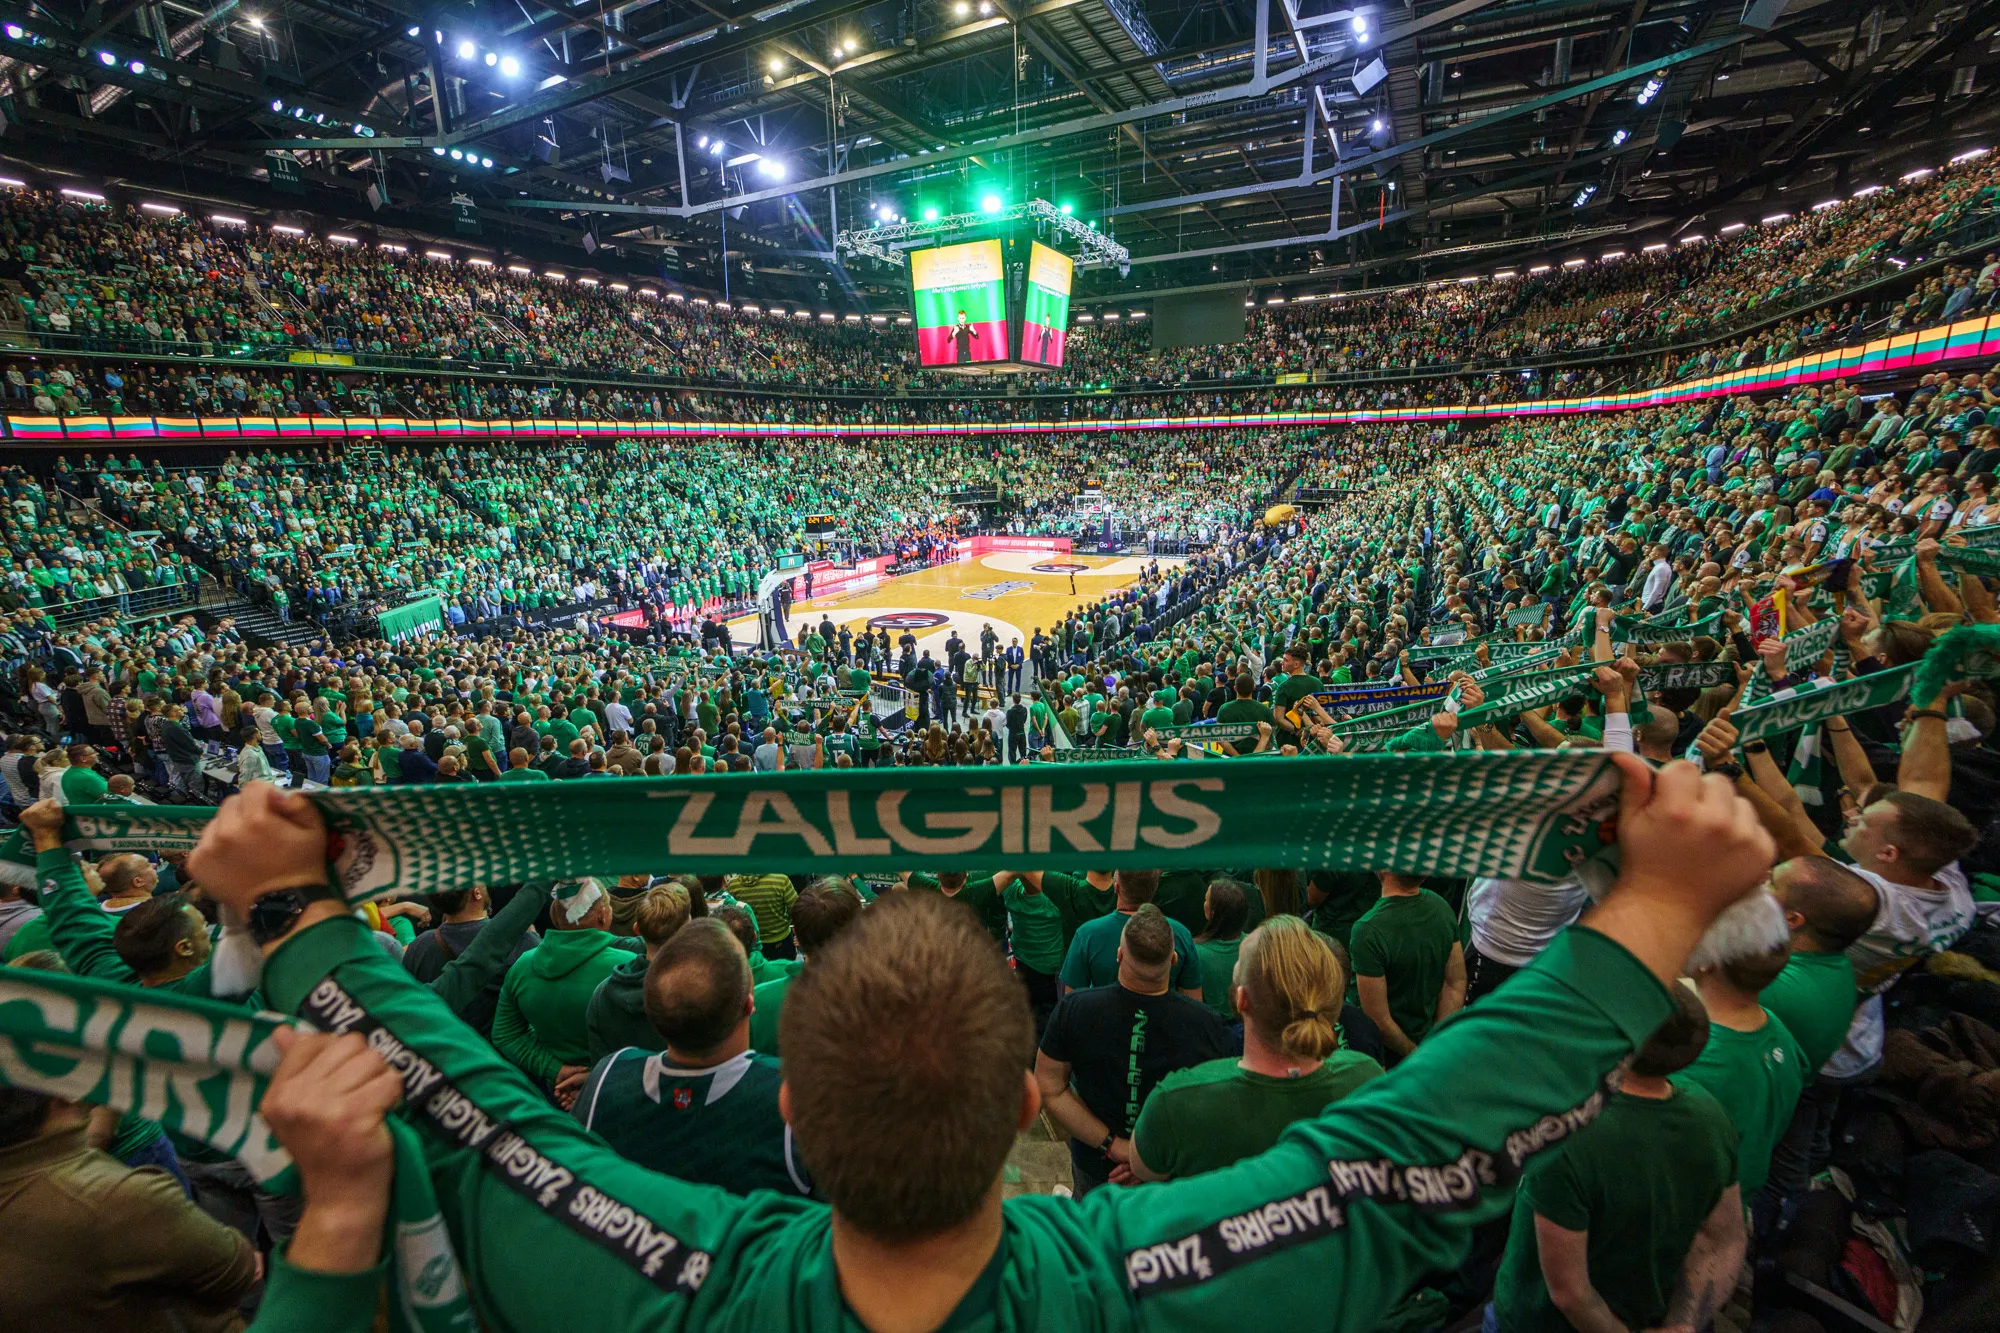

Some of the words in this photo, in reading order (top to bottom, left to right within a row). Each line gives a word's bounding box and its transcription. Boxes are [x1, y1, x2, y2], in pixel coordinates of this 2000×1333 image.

[1664, 665, 1721, 689] RAS
[1317, 691, 1368, 705] SLAVA
[860, 724, 869, 734] 25
[1156, 729, 1176, 740] BC
[1219, 1186, 1345, 1253] ŽALGIRIS
[568, 1186, 678, 1277] ŽALGIRIS
